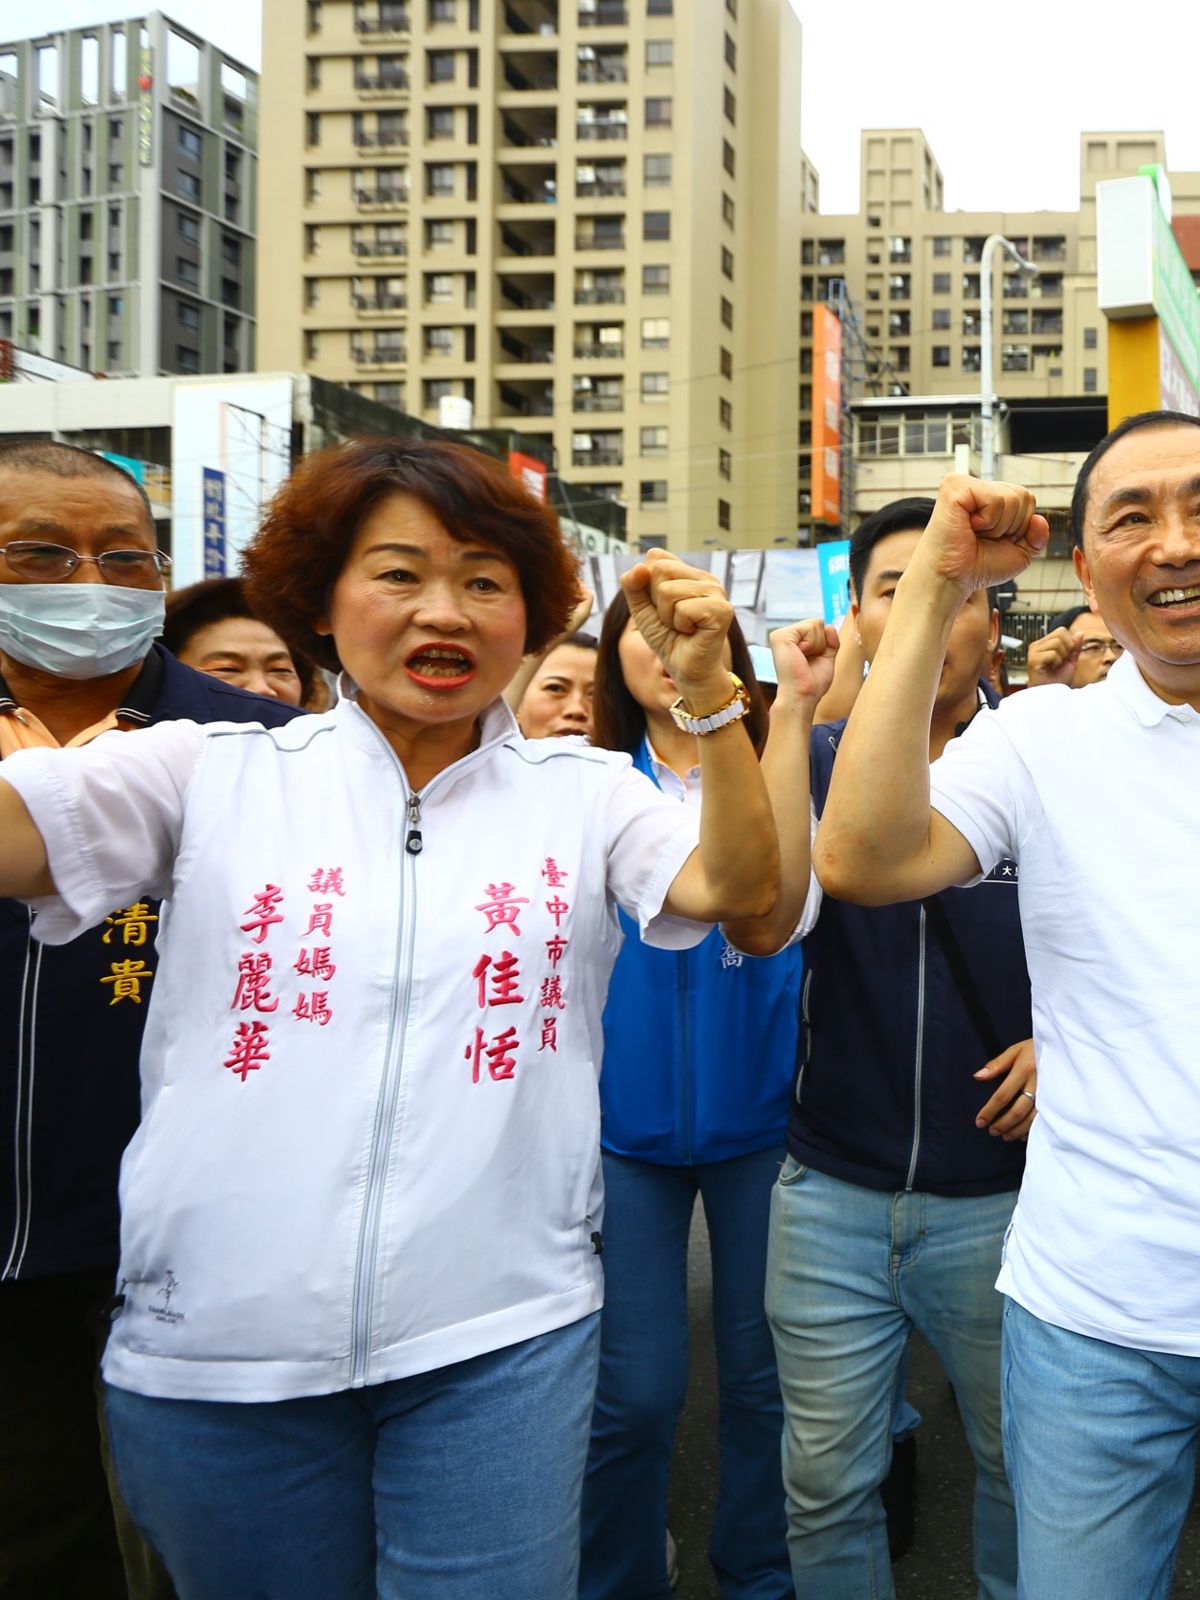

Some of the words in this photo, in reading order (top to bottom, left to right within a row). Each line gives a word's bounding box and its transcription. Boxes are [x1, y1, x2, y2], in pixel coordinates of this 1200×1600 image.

[99, 902, 159, 1006] 清貴
[223, 884, 285, 1083] 李麗華
[291, 867, 346, 1026] 議員媽媽
[464, 882, 530, 1084] 黃佳恬
[537, 857, 570, 1053] 臺中市議員
